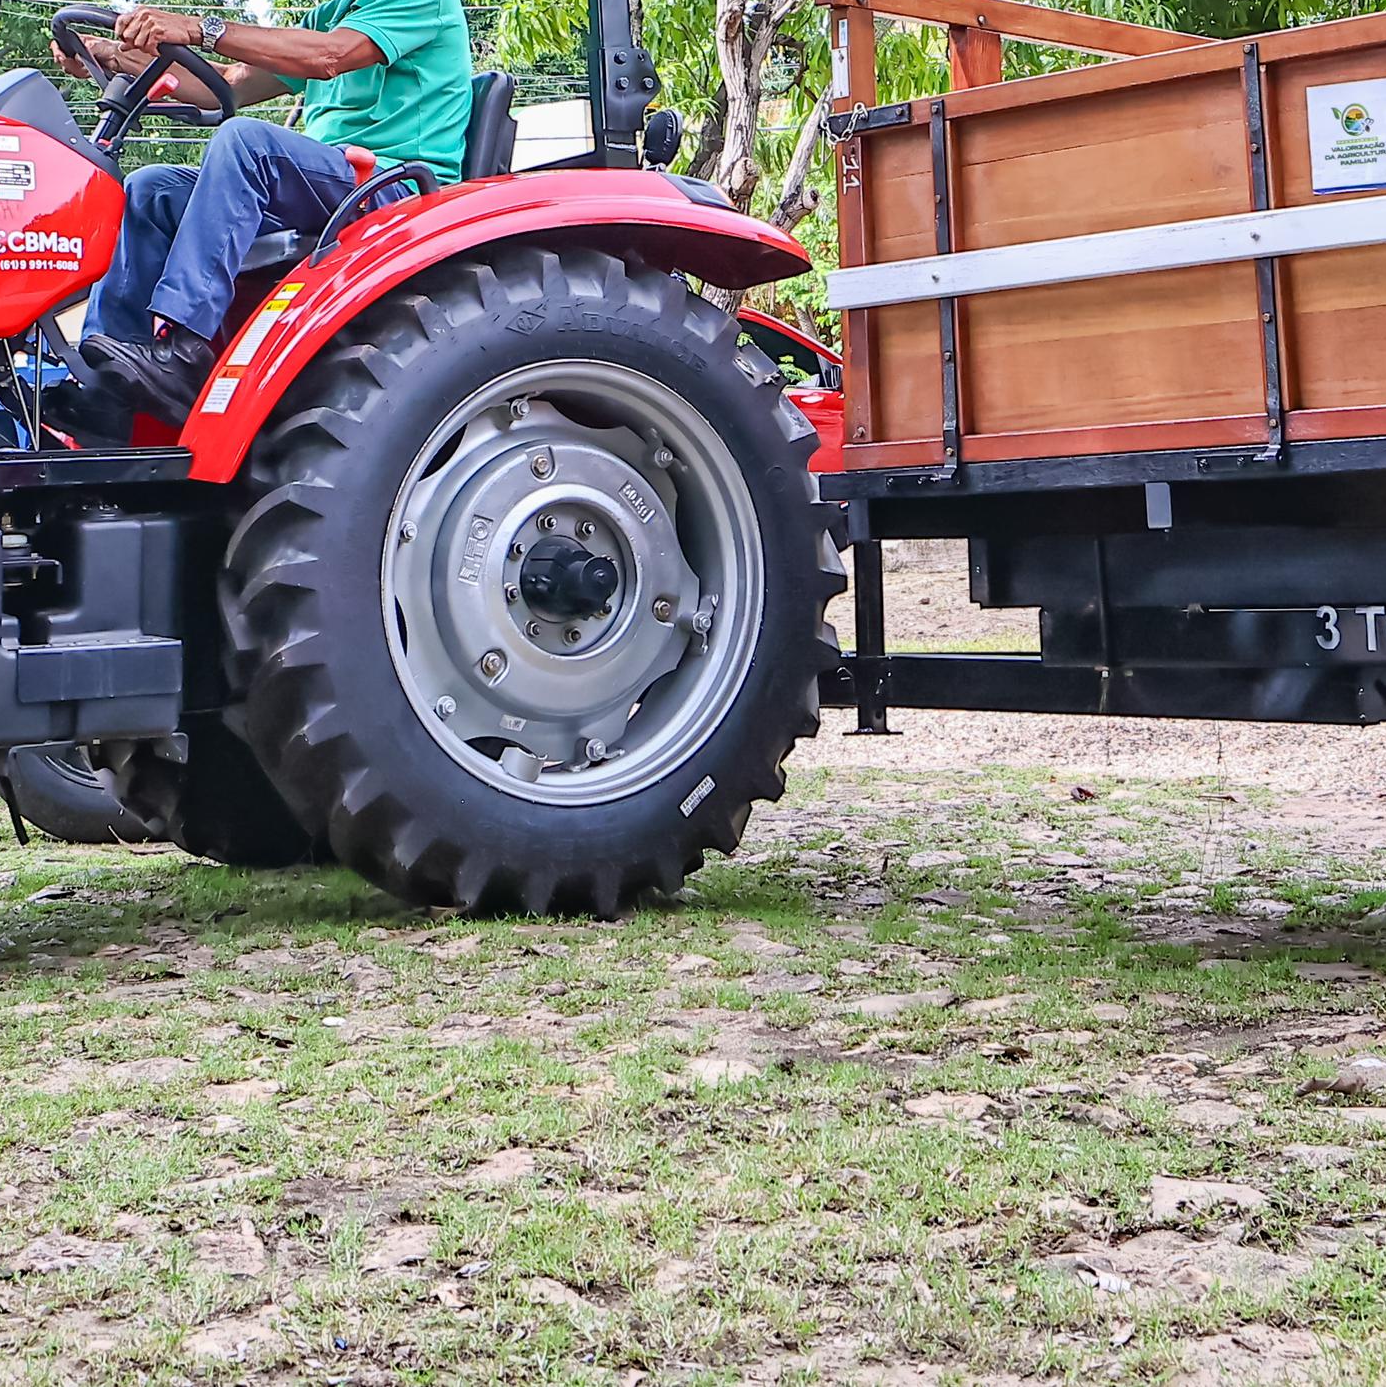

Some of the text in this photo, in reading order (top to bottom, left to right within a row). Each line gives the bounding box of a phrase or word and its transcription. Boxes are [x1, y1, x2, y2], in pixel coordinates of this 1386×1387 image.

[1331, 142, 1385, 152] VALORIZAÇÃO
[1340, 157, 1378, 166] FAMILIAR
[7, 231, 83, 259] CBMaq
[1314, 604, 1341, 651] 3
